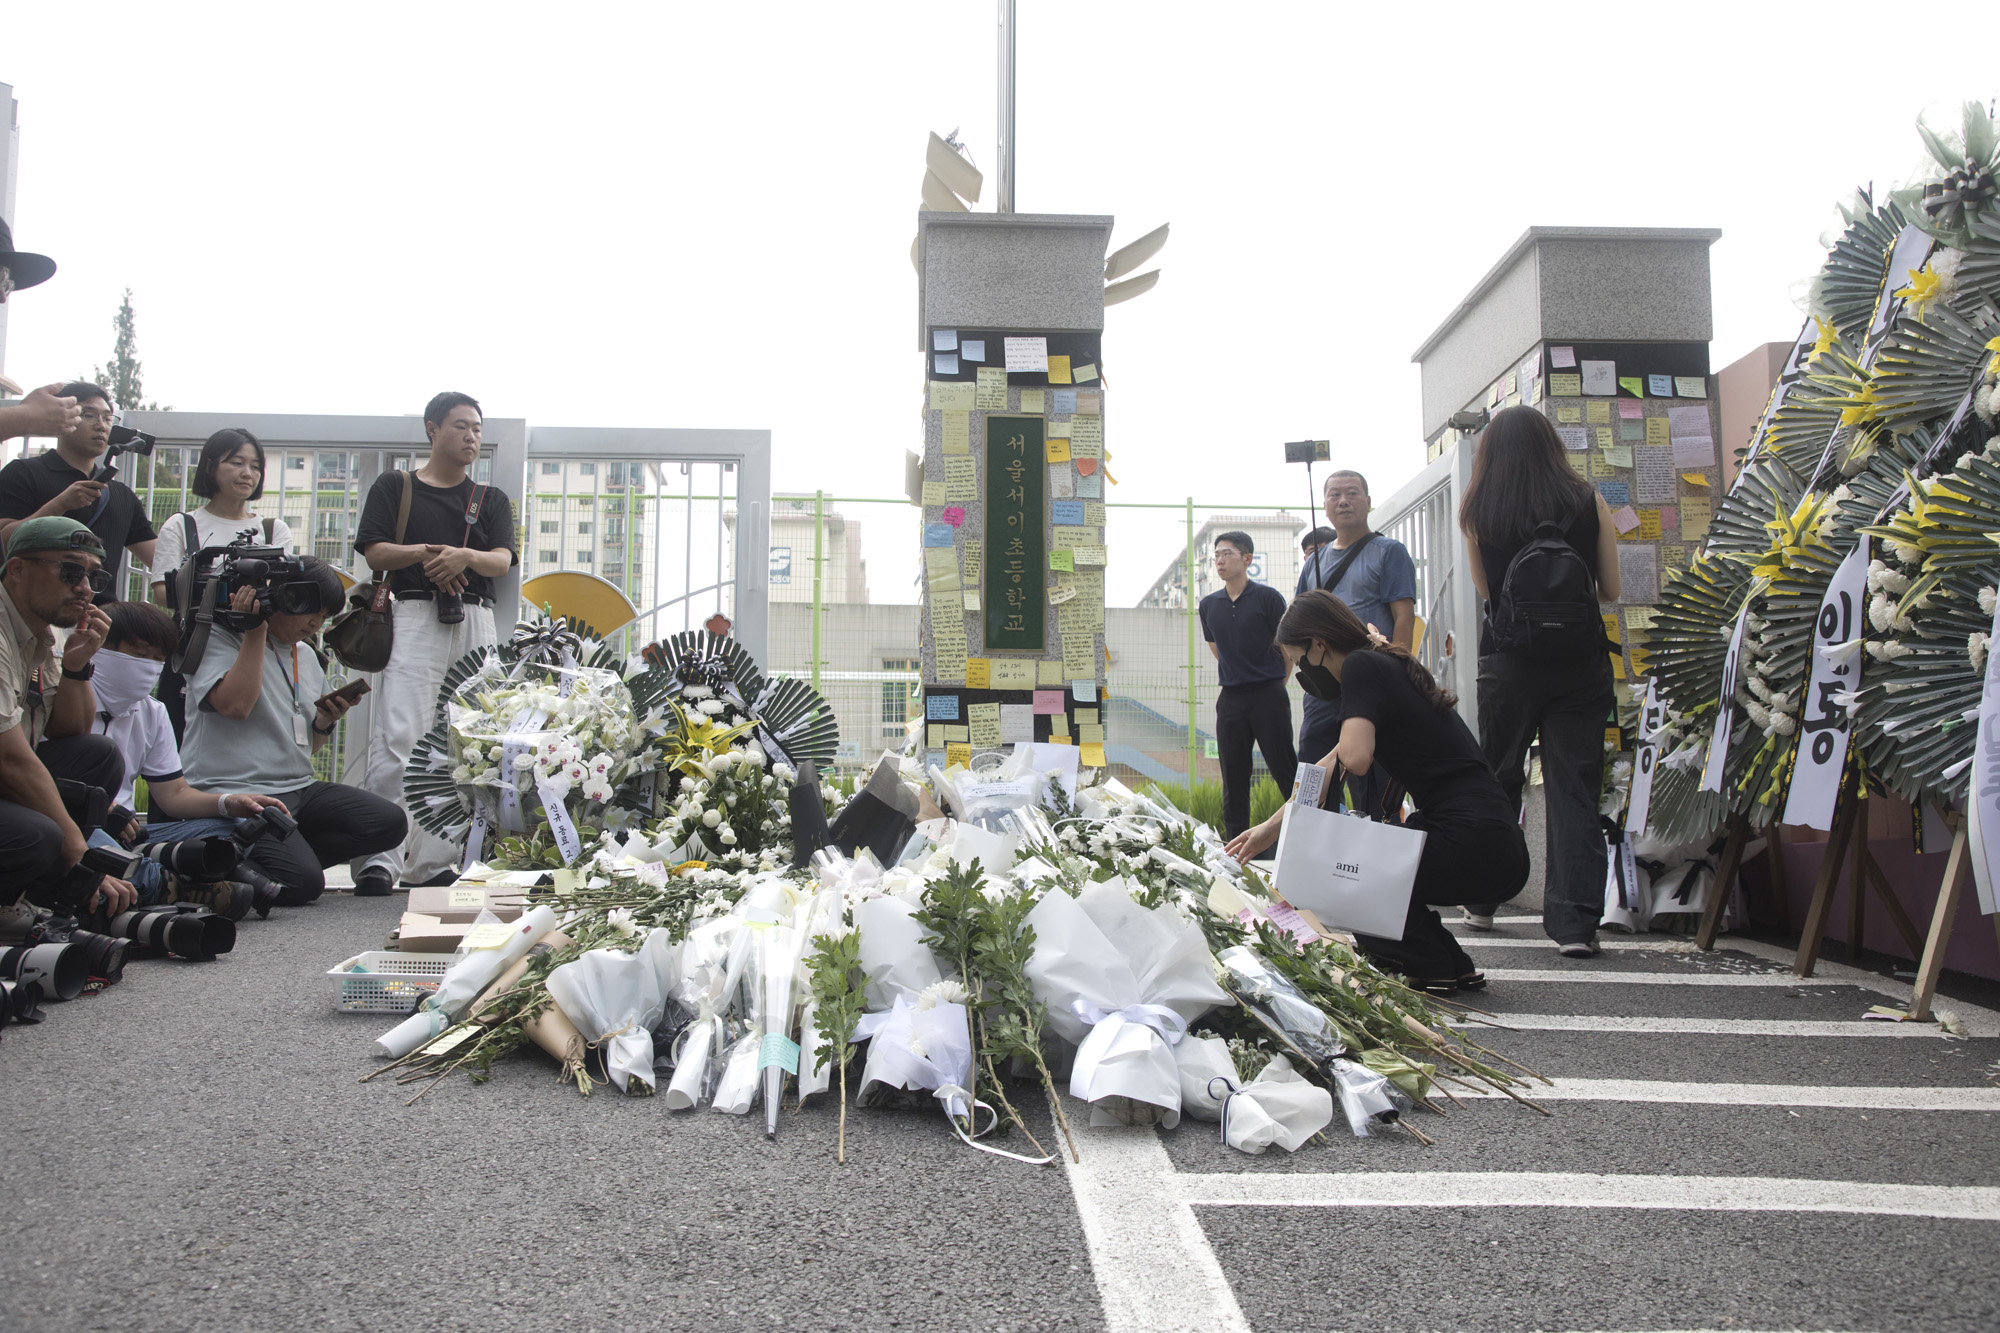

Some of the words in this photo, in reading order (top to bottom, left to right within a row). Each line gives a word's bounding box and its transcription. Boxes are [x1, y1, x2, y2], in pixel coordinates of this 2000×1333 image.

[1004, 434, 1025, 632] 서울서이초등학교
[377, 588, 388, 608] PRESS
[1336, 862, 1359, 874] ami
